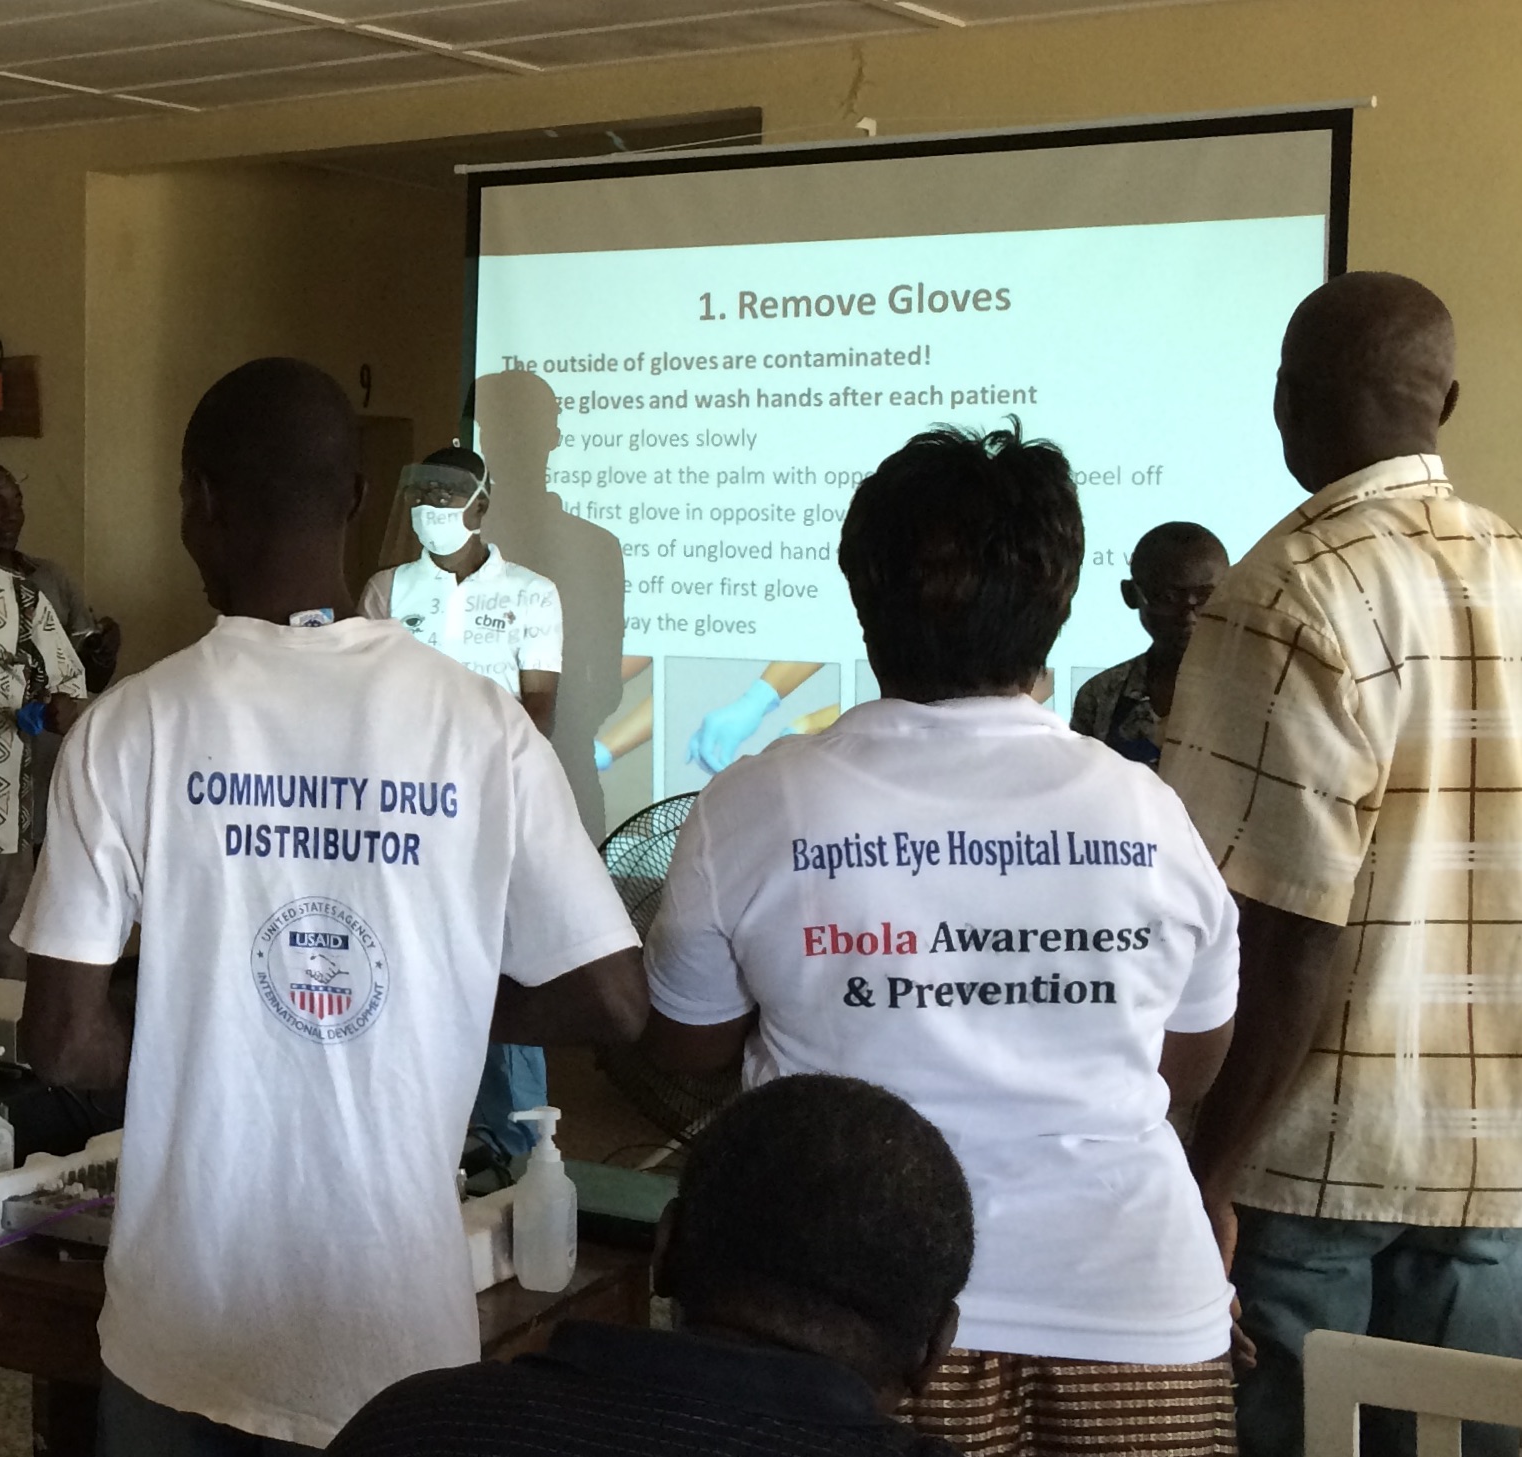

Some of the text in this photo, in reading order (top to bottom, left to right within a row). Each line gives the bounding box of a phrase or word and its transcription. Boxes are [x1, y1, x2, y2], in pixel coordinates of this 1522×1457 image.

[699, 282, 1012, 321] 1. Remove Gloves
[501, 345, 931, 376] The outside of gloves are contaminated!
[579, 390, 645, 414] gloves
[649, 390, 688, 409] and
[695, 388, 750, 408] wash
[756, 387, 823, 408] hands
[829, 386, 883, 407] after
[888, 385, 943, 406] each
[950, 384, 1038, 409] patient
[581, 433, 623, 451] your
[629, 428, 689, 451] gloves
[695, 428, 758, 451] slowly
[597, 465, 647, 488] glove
[653, 469, 672, 485] at
[677, 466, 710, 485] the
[716, 465, 765, 489] palm
[773, 465, 817, 485] with
[1075, 464, 1121, 486] peel
[1131, 464, 1165, 486] off
[587, 500, 622, 520] first
[629, 502, 680, 525] glove
[686, 502, 703, 521] in
[709, 502, 796, 526] opposite
[657, 539, 677, 558] of
[683, 540, 773, 563] ungloved
[780, 541, 830, 561] hand
[1093, 548, 1115, 566] at
[465, 592, 512, 613] Slide
[638, 575, 665, 594] off
[671, 581, 714, 596] over
[719, 577, 758, 598] first
[764, 578, 819, 602] glove
[474, 614, 506, 630] cbm
[657, 613, 689, 632] the
[694, 614, 757, 637] gloves
[463, 629, 500, 645] Peel
[186, 771, 458, 818] COMMUNITY DRUG
[225, 824, 421, 865] DISTRIBUTOR
[792, 829, 1158, 879] Baptist Eye Hospital Lunsar
[261, 902, 376, 949] UNITED STATES AGENCY
[803, 920, 1152, 957] Ebola Awareness
[295, 932, 343, 949] USAID
[843, 972, 1118, 1009] & Prevention
[257, 971, 385, 1040] INTERNATIONAL DEVELOPMENT
